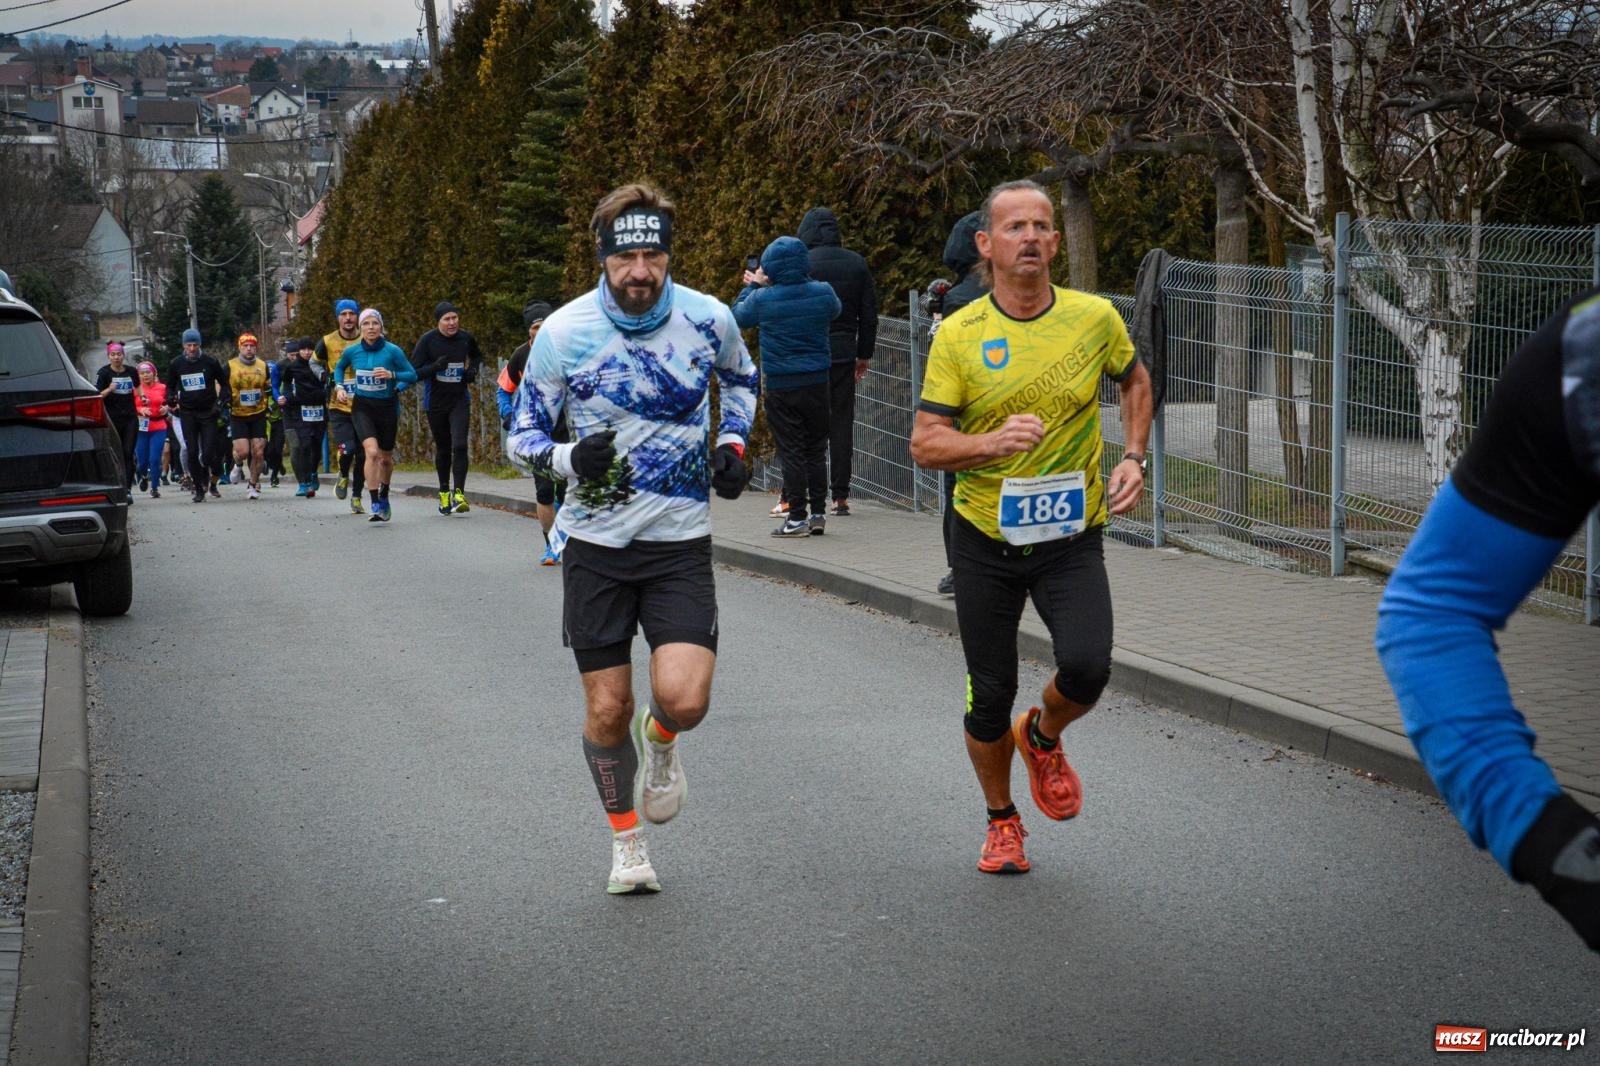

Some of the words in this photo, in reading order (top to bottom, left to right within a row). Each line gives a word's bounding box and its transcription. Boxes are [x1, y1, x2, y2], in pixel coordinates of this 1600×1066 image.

[614, 214, 661, 232] BIEG
[614, 229, 661, 246] ZBÓJA
[445, 368, 457, 377] 84
[1016, 491, 1072, 525] 186
